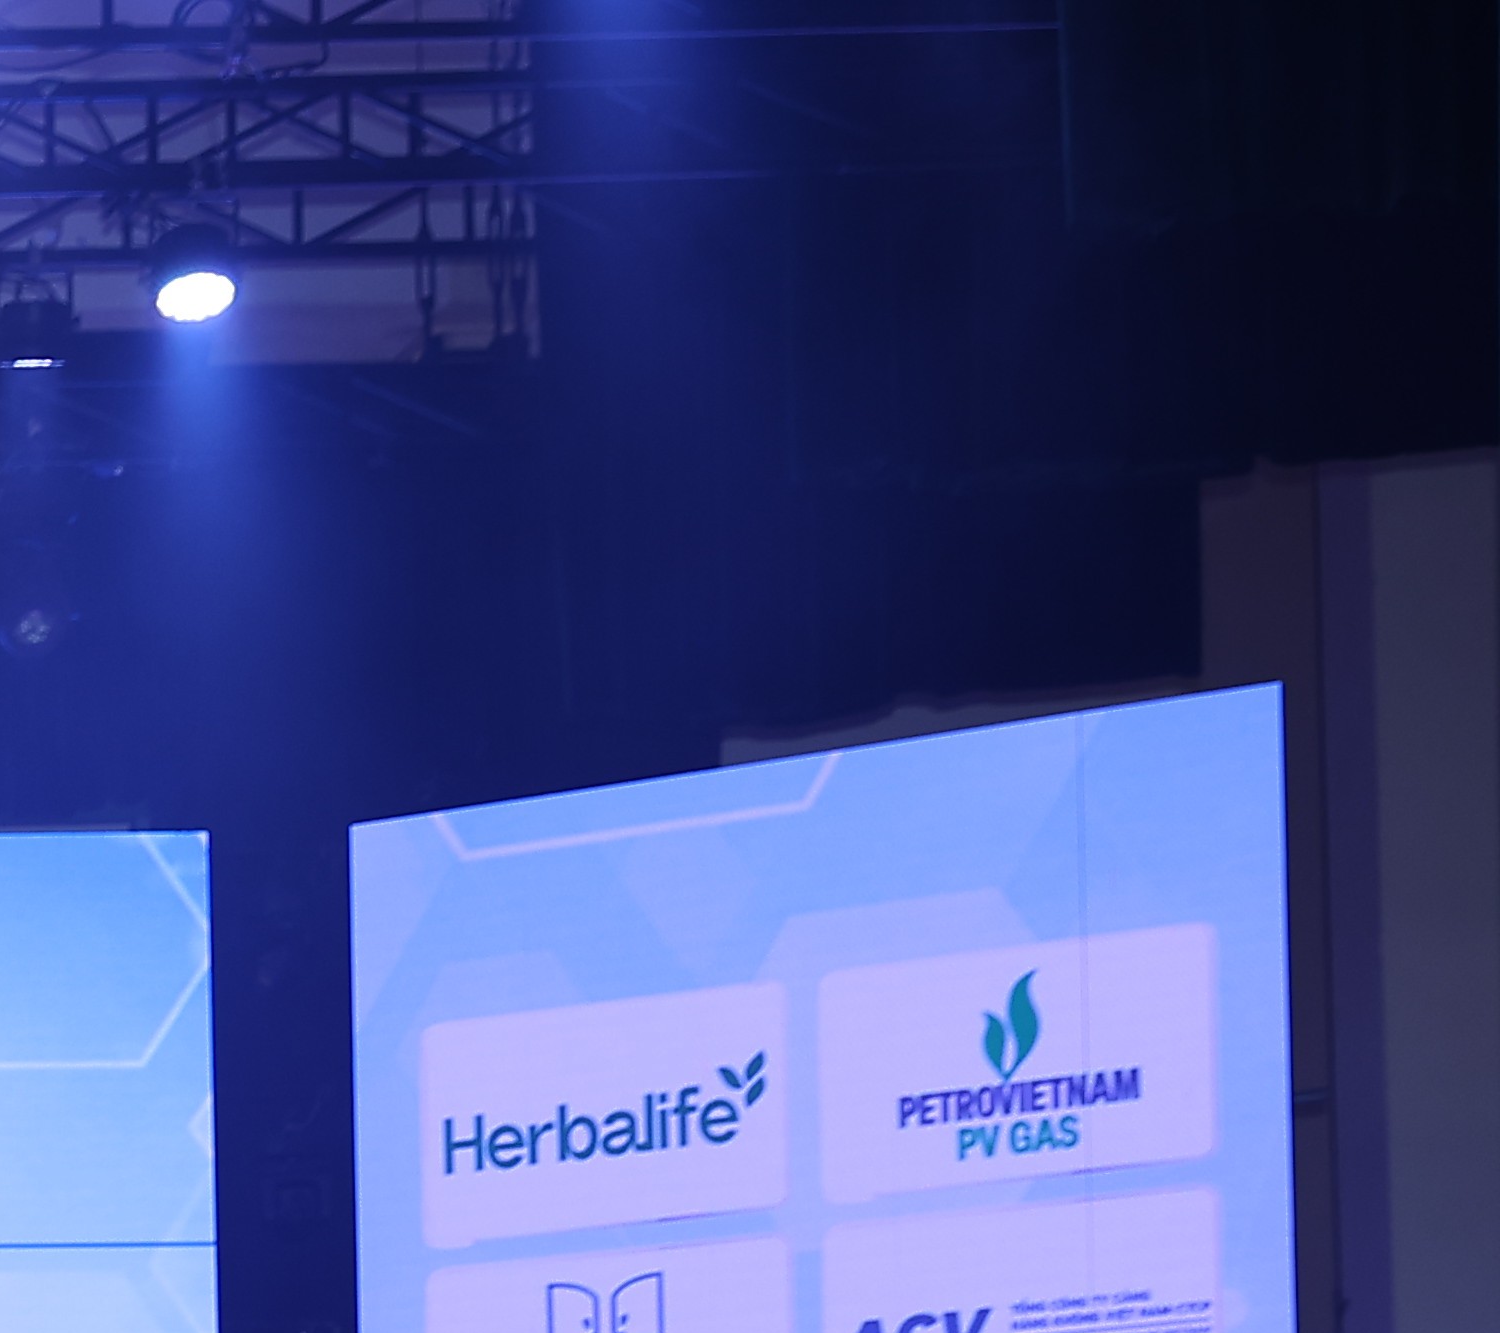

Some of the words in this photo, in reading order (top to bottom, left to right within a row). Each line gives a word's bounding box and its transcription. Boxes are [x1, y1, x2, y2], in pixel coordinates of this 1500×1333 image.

[443, 1084, 740, 1174] Herbalife
[899, 1067, 1142, 1129] PETROVIETNAM
[957, 1126, 1004, 1160] PV
[1010, 1115, 1080, 1154] GAS
